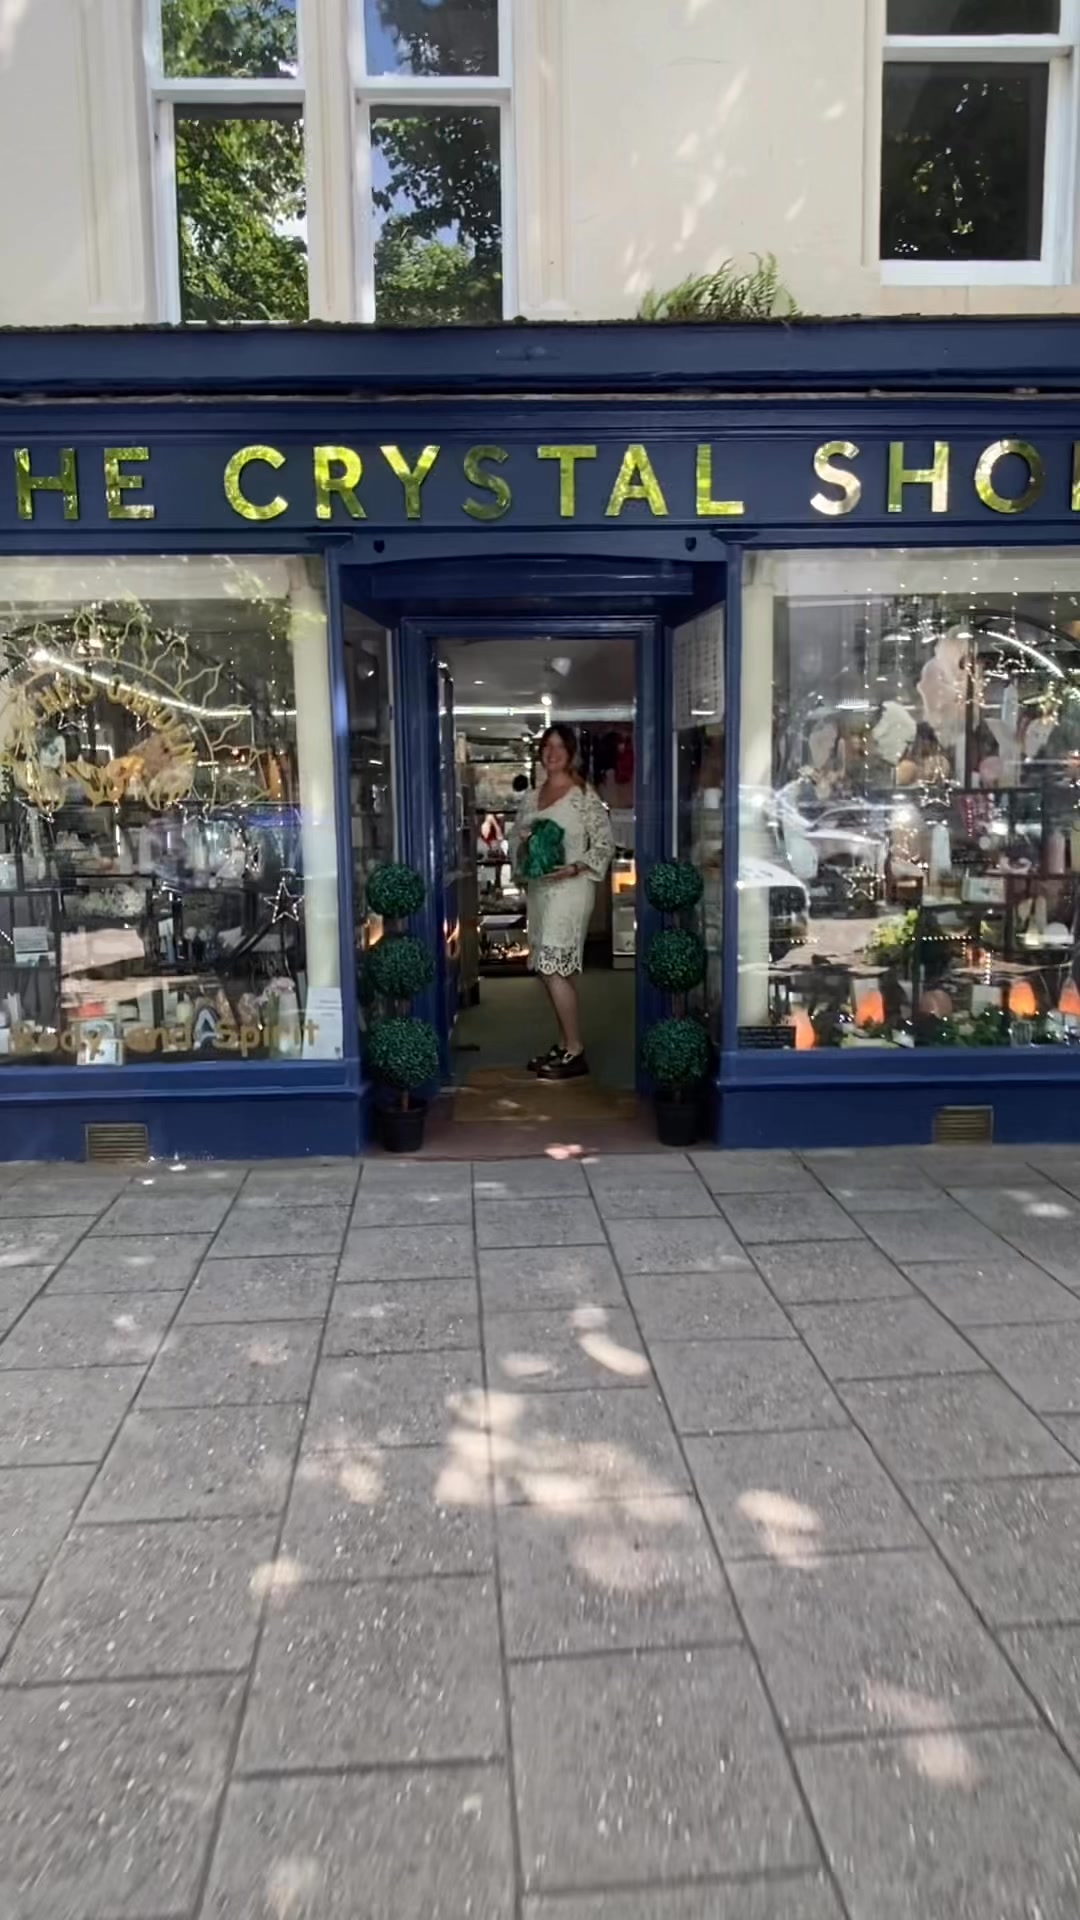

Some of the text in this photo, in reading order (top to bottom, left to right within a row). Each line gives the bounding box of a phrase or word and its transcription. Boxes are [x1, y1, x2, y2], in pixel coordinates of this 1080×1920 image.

[223, 443, 745, 521] CRYSTAL
[810, 438, 1080, 516] SHO
[212, 1018, 320, 1058] Spirit
